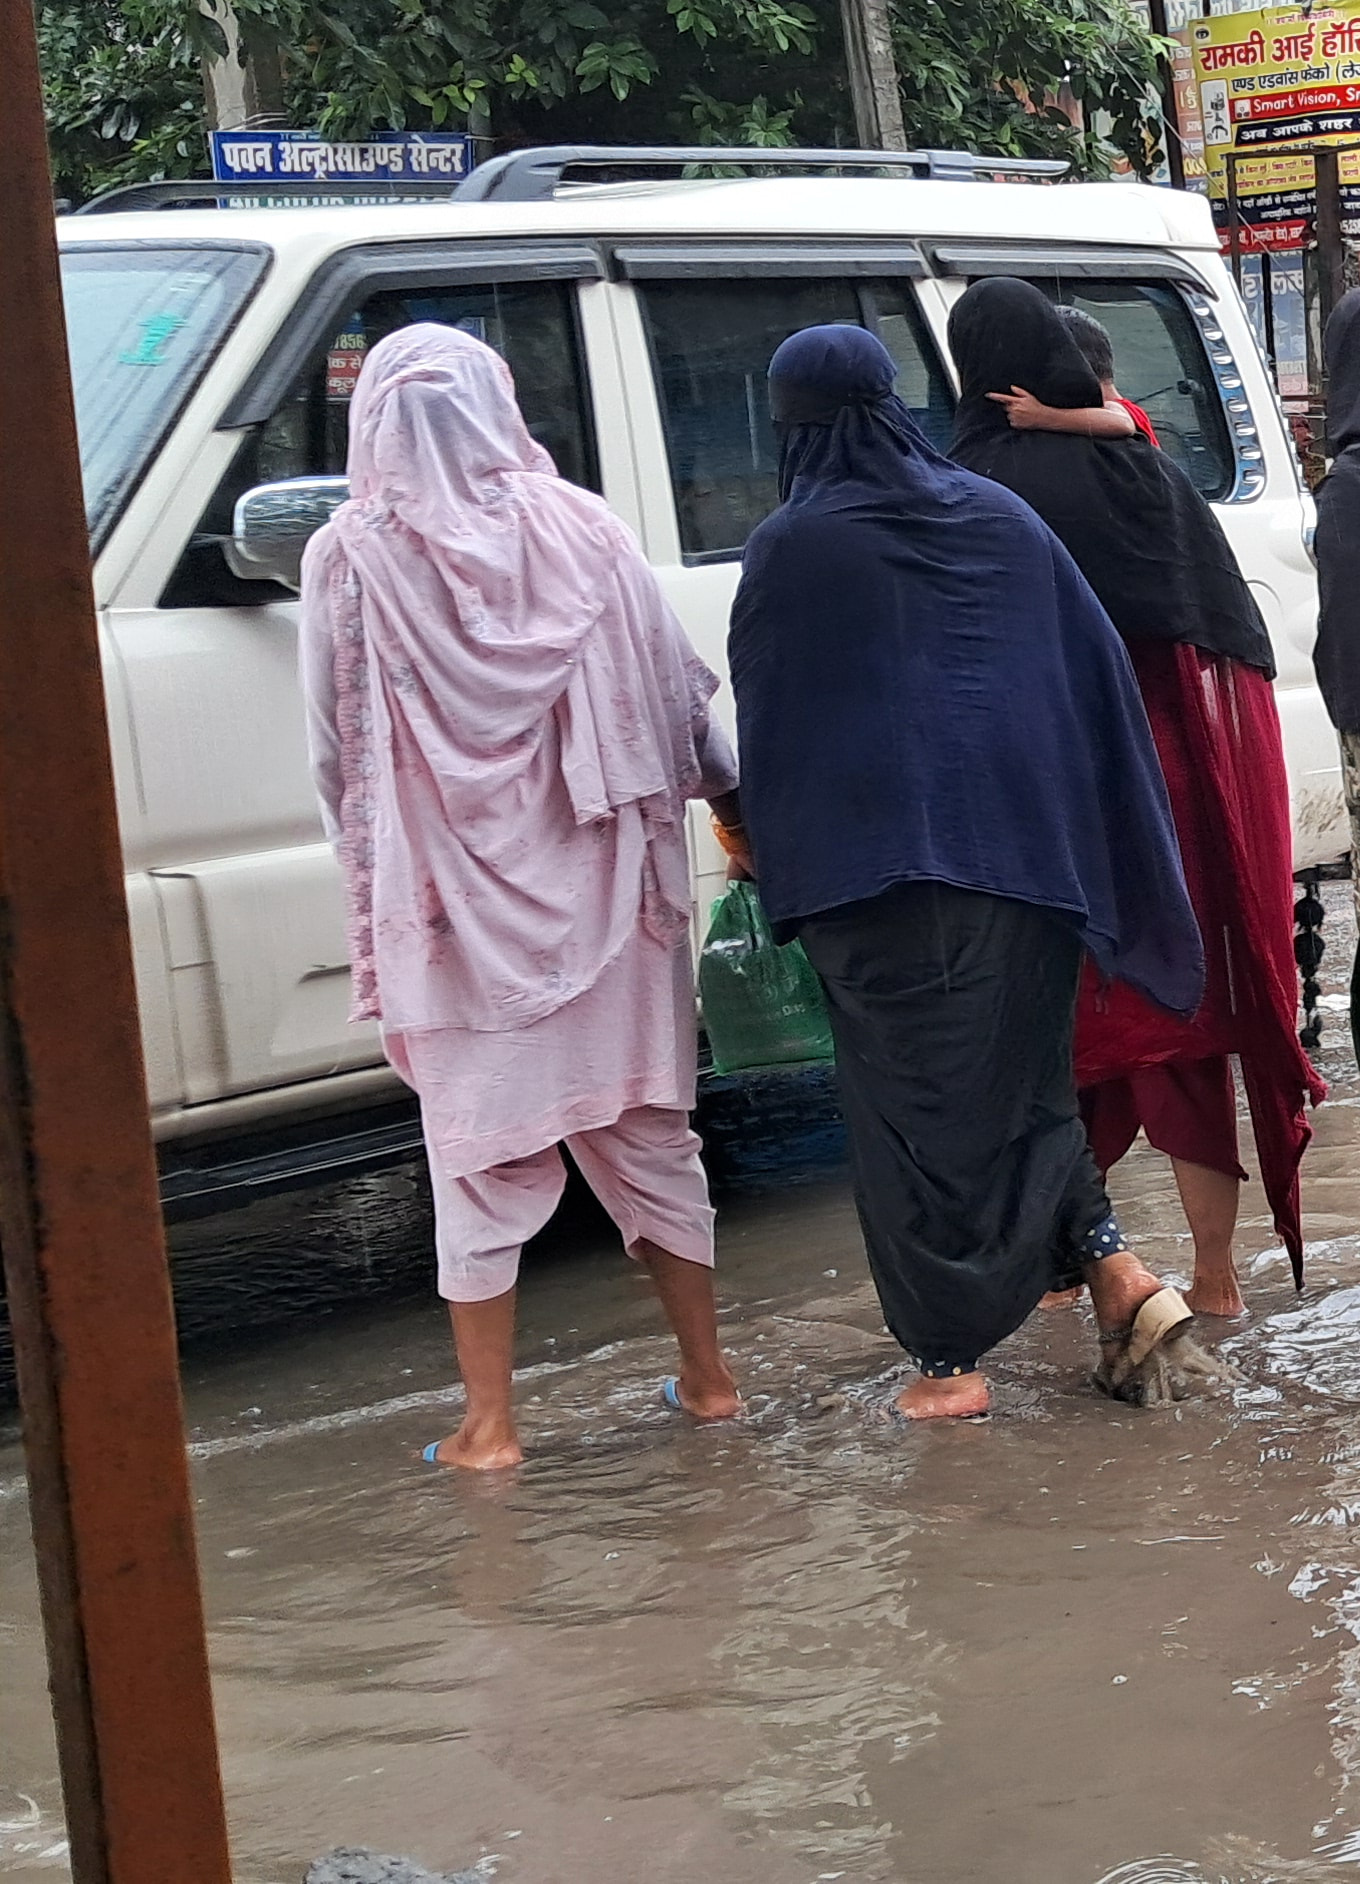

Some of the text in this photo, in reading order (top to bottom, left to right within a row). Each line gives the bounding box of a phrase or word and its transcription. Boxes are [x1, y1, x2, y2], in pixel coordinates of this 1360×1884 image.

[1199, 29, 1265, 72] रामकी
[1272, 22, 1315, 62] आई
[1258, 68, 1298, 89] एडवांस
[1300, 62, 1330, 82] फेको
[1253, 97, 1294, 113] Smart
[1297, 91, 1341, 108] Vision,
[1240, 128, 1267, 141] अब
[1272, 120, 1313, 137] आपके
[1319, 116, 1354, 131] शहर
[221, 133, 465, 180] पवन अल्ट्रासाउण्ड सेन्टर
